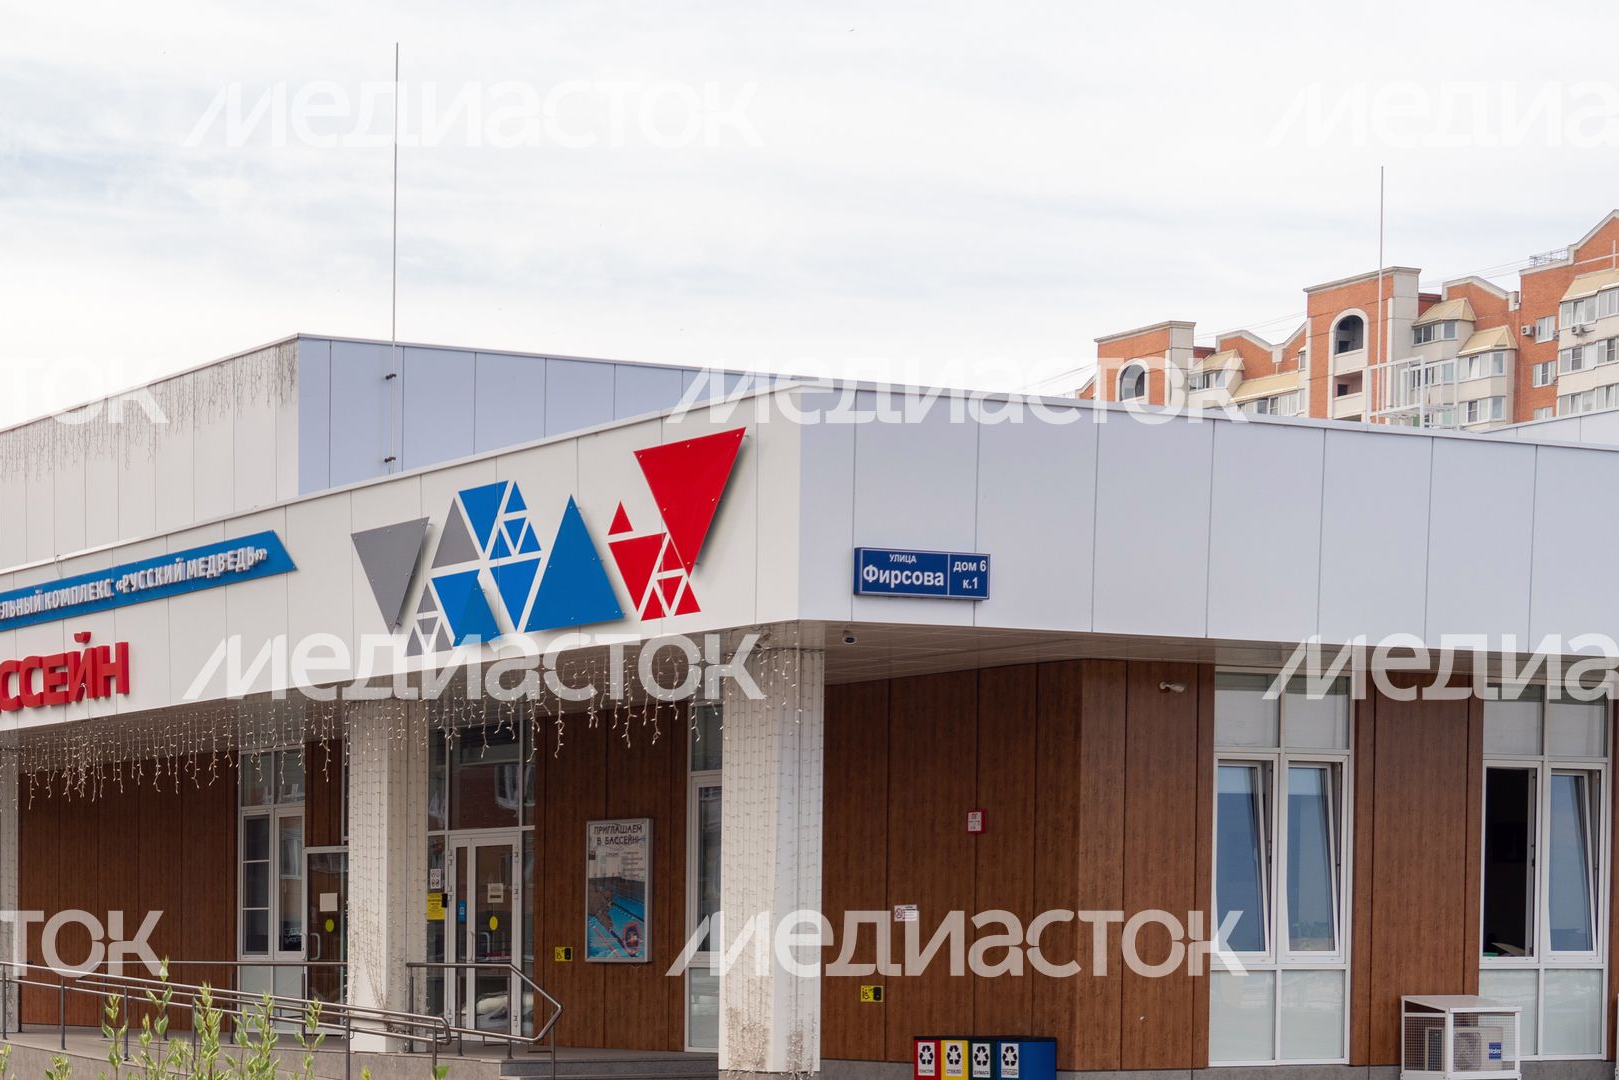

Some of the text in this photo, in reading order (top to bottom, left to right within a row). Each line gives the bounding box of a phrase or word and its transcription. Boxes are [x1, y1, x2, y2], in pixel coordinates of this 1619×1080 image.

[889, 554, 917, 564] УЛИЦА
[953, 560, 987, 573] дом 6
[45, 578, 115, 607] КОМПЛЕКС
[115, 557, 185, 594] «РУССКИЙ
[186, 546, 267, 579] МЕДВЕДЬ»
[863, 564, 945, 588] Фирсова
[962, 577, 979, 589] к.1
[594, 824, 642, 835] ПРИГЛАШАЕМ
[597, 837, 602, 846] В
